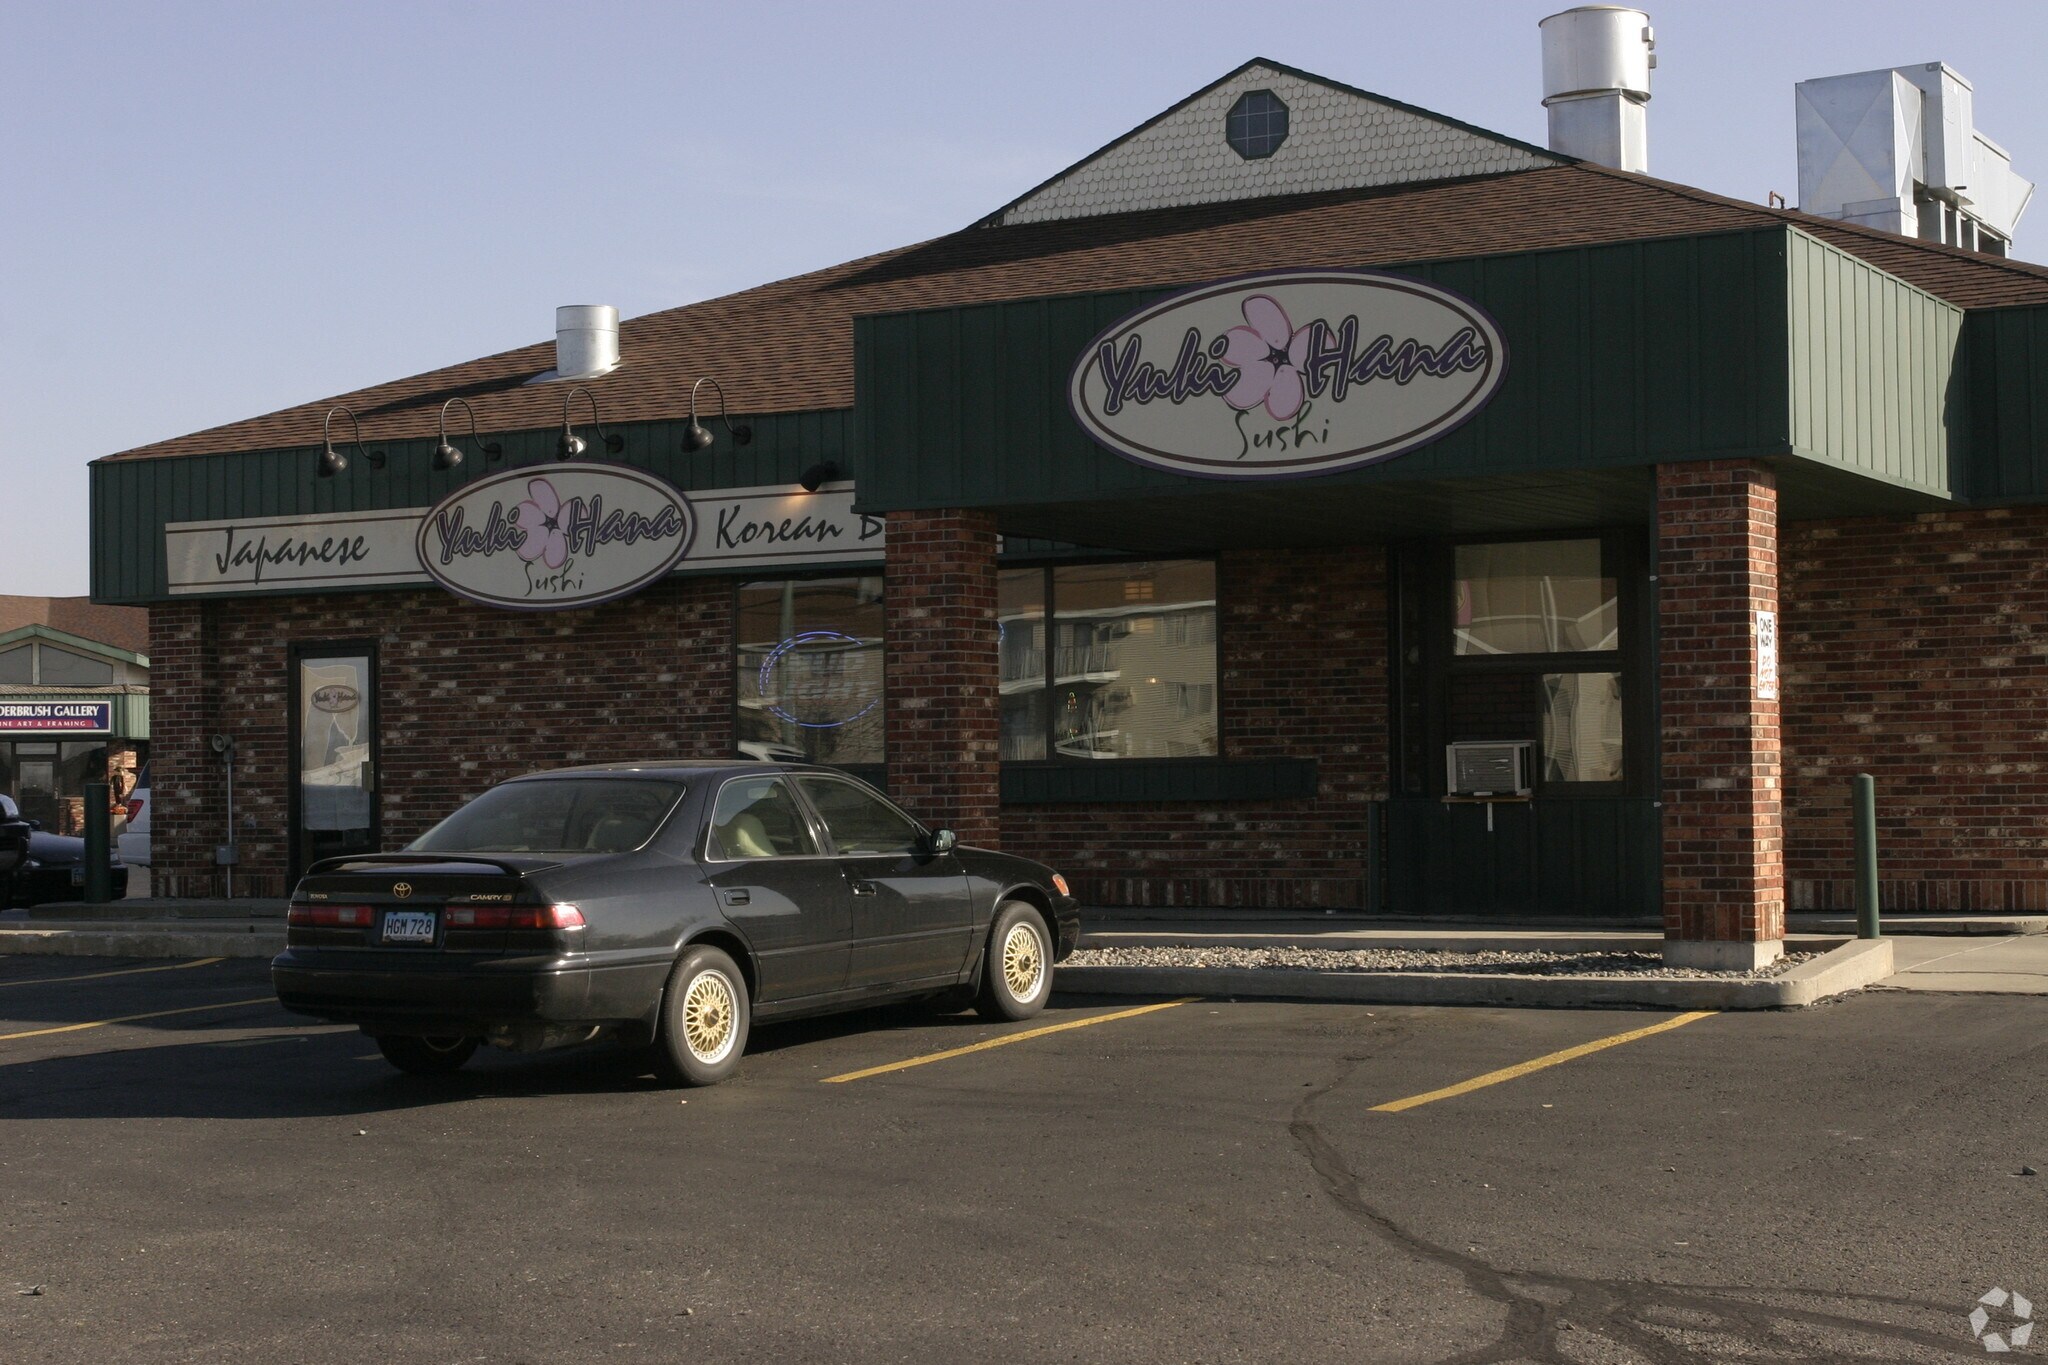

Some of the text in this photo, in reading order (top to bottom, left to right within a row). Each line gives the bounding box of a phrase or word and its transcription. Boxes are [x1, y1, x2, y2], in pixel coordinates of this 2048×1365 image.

[1098, 315, 1487, 415] Yuki Hana
[1234, 400, 1330, 460] Sushi
[436, 493, 682, 565] Yuki Hana
[715, 505, 844, 549] Korean
[216, 525, 370, 585] Japanese
[524, 558, 585, 597] Sushi
[1759, 617, 1773, 633] ONE
[1760, 635, 1773, 648] WAY
[1759, 668, 1773, 679] NOT
[1762, 655, 1772, 667] DO
[54, 705, 99, 716] GALLERY
[385, 918, 433, 935] HGM 728
